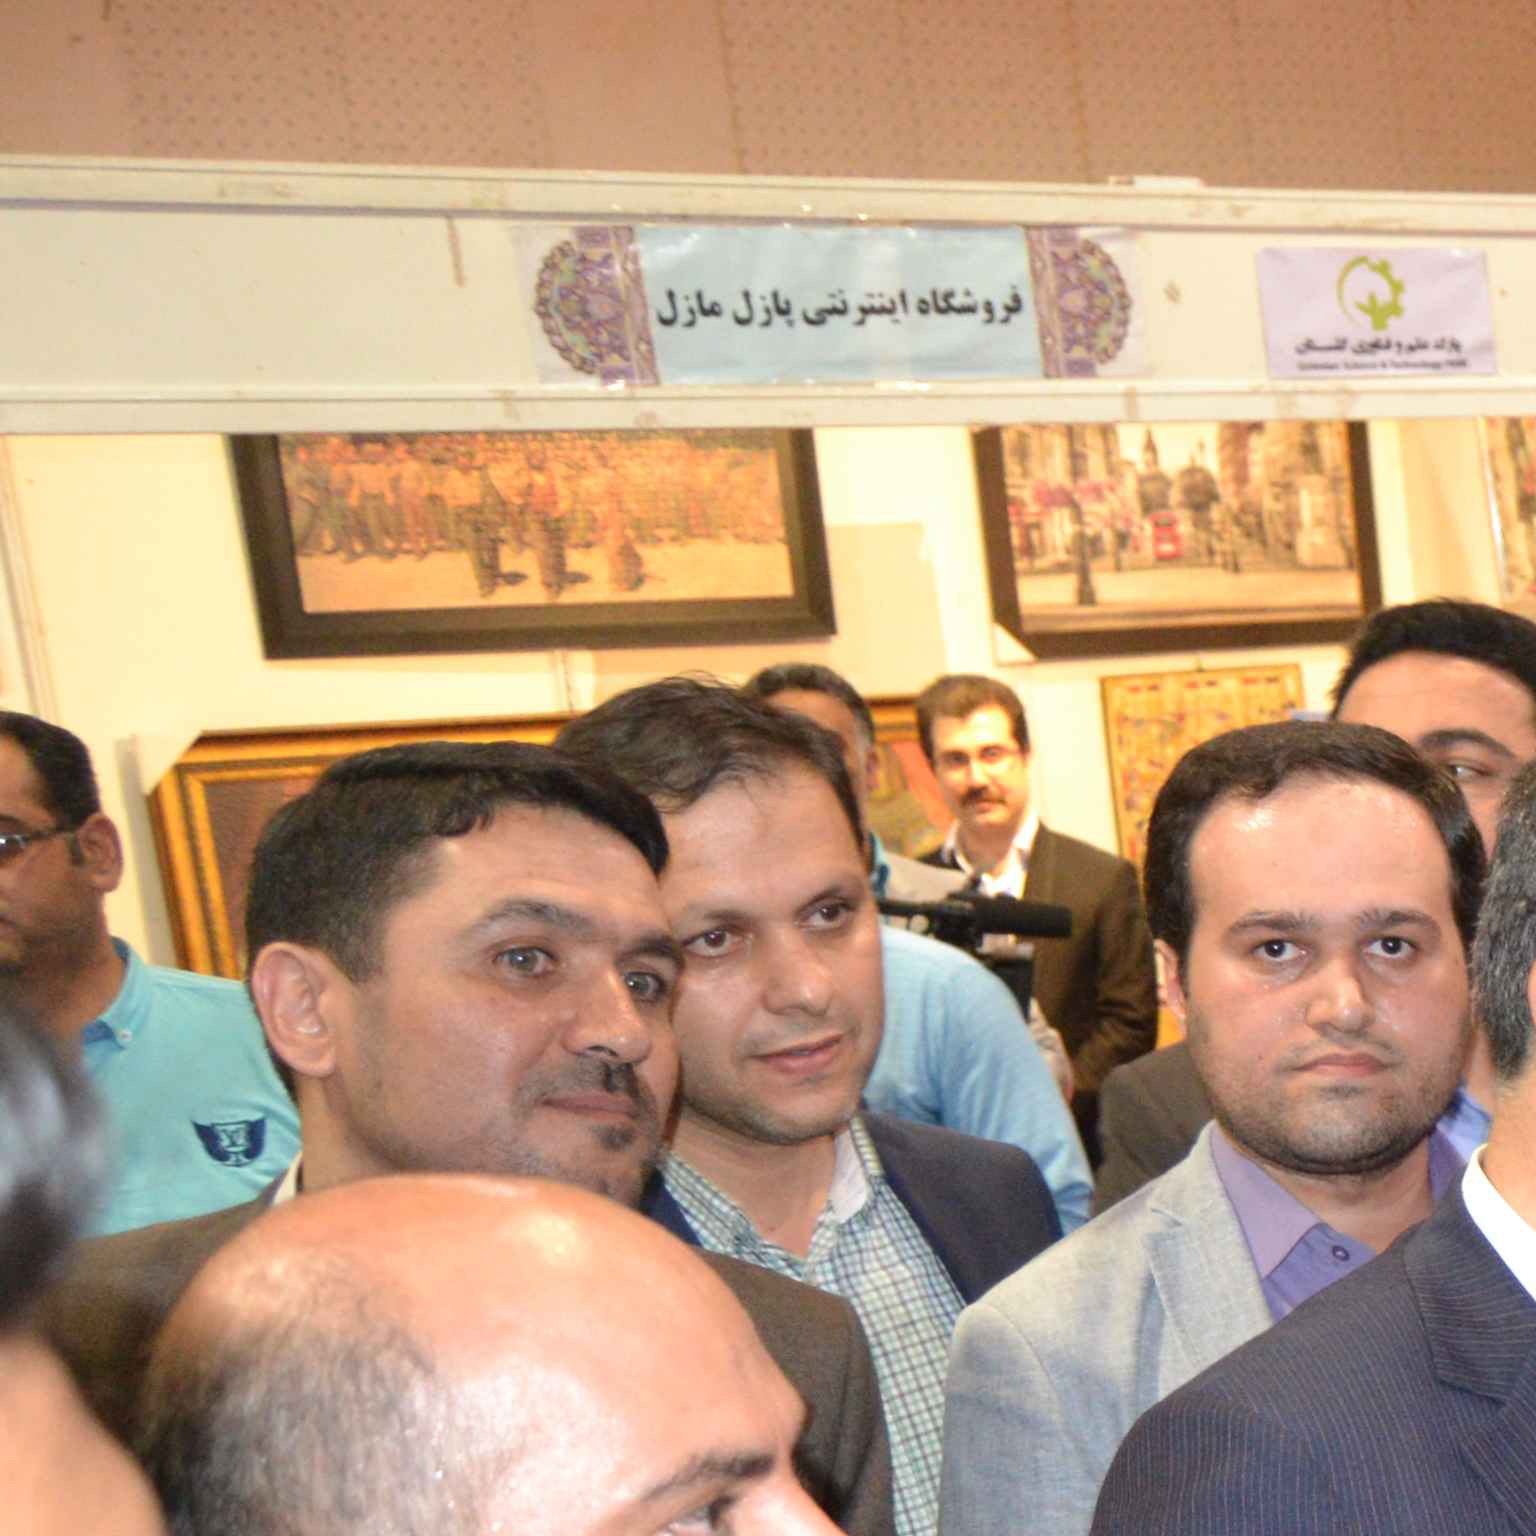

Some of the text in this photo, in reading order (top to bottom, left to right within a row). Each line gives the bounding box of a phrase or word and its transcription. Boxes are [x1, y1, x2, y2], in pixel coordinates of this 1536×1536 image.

[656, 284, 1022, 327] فروشگاه اینترنتی پازل مازل
